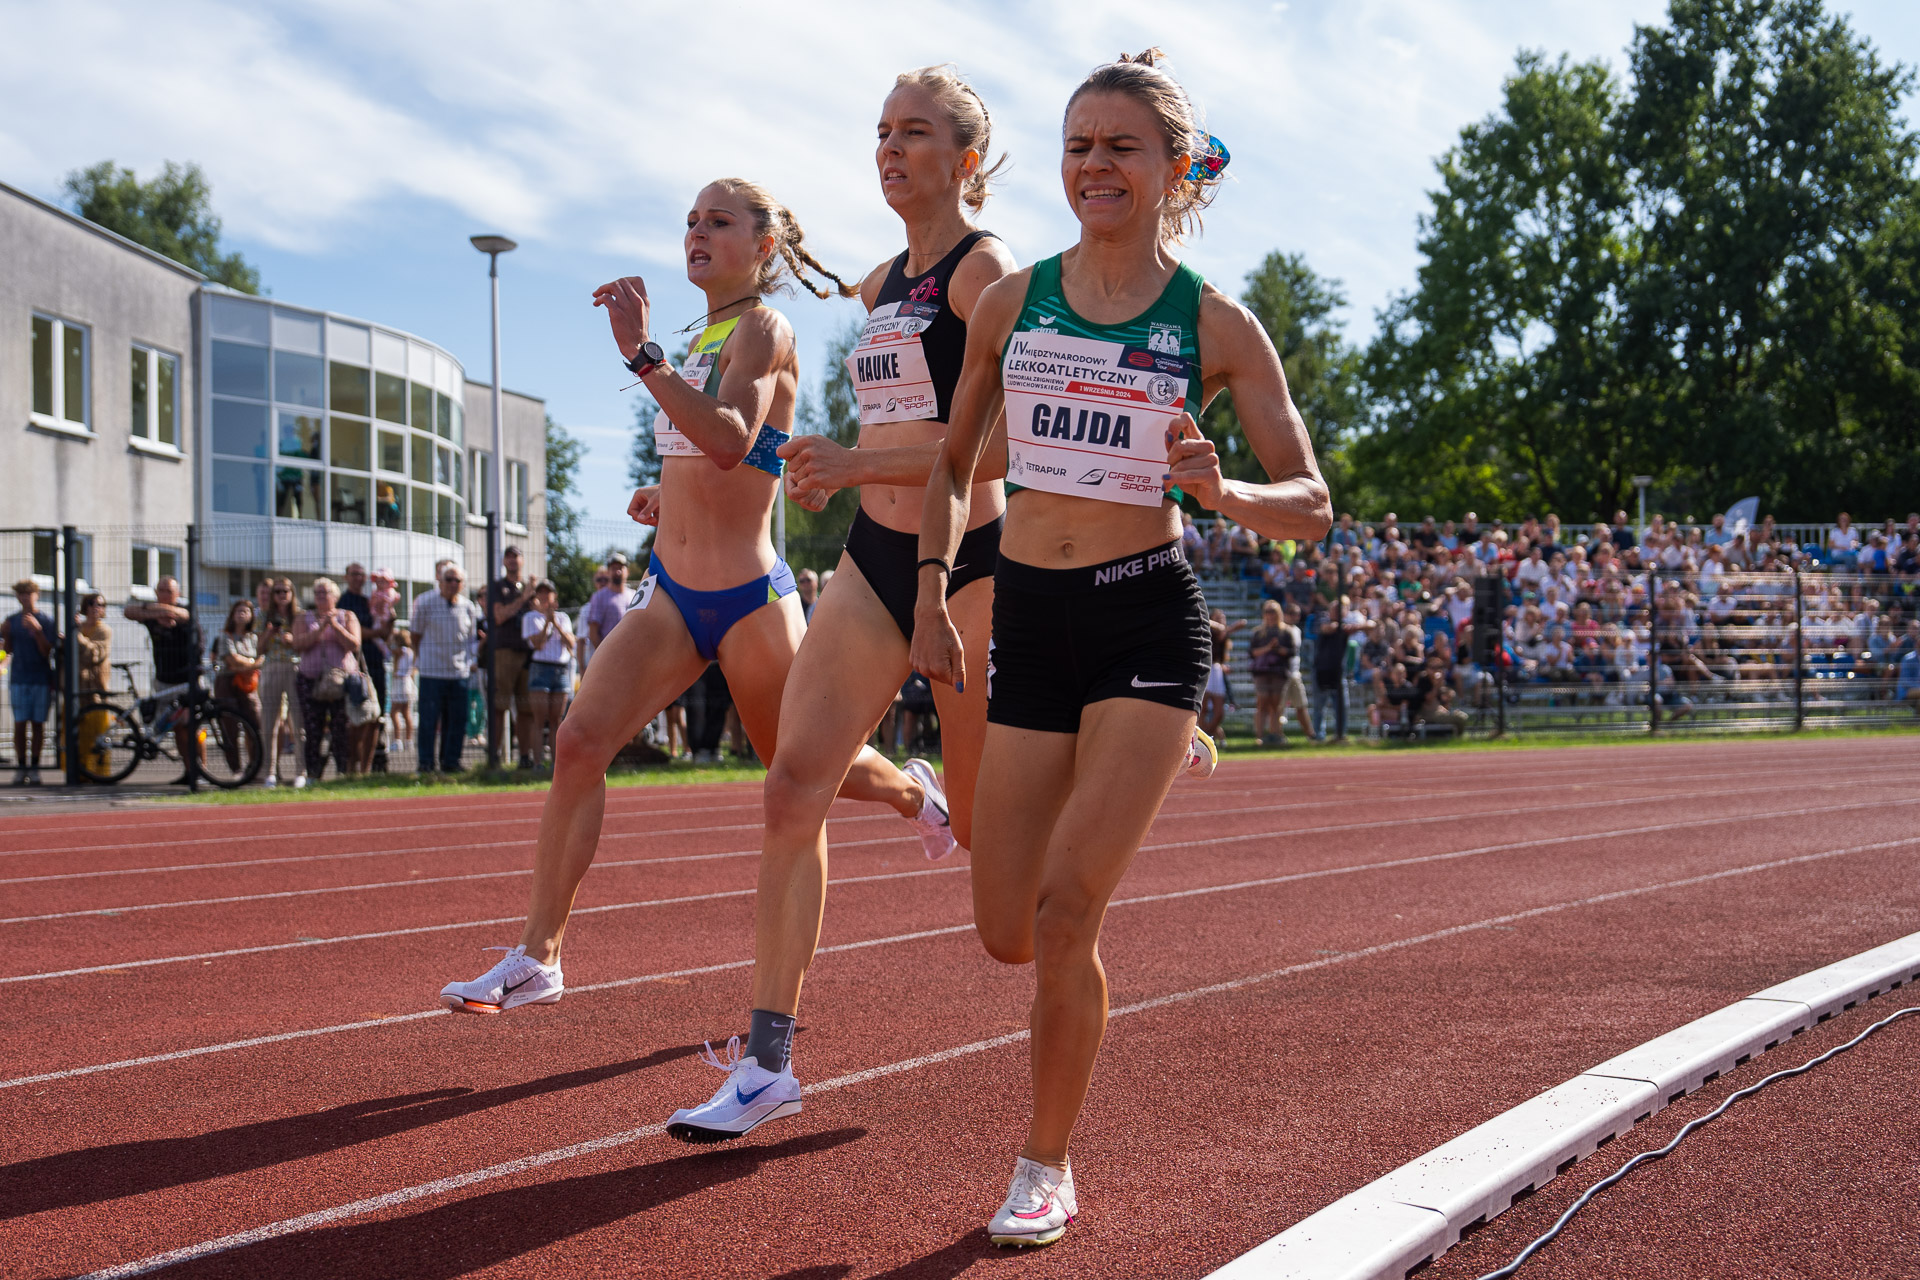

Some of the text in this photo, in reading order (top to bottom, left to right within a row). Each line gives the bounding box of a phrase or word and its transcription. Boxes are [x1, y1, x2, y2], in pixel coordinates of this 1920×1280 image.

[1150, 321, 1181, 329] WARSZAWA
[1013, 341, 1108, 366] IV MIĘDZYNARODOWY
[857, 352, 901, 383] HAUKE
[1008, 359, 1138, 386] LEKKOATLETYCZNY
[1007, 373, 1065, 385] MEMORIAŁ ZBIGNIEWA
[1007, 380, 1065, 392] LUDWICHOWSKIEGO
[1083, 386, 1115, 397] WRZEŚNIA
[1115, 390, 1132, 398] 2024
[904, 399, 935, 410] SPORT
[1031, 402, 1131, 450] GAJDA
[1025, 460, 1067, 477] TETRAPUR
[1120, 482, 1162, 494] SPORT
[1094, 546, 1180, 586] NIKE PRO
